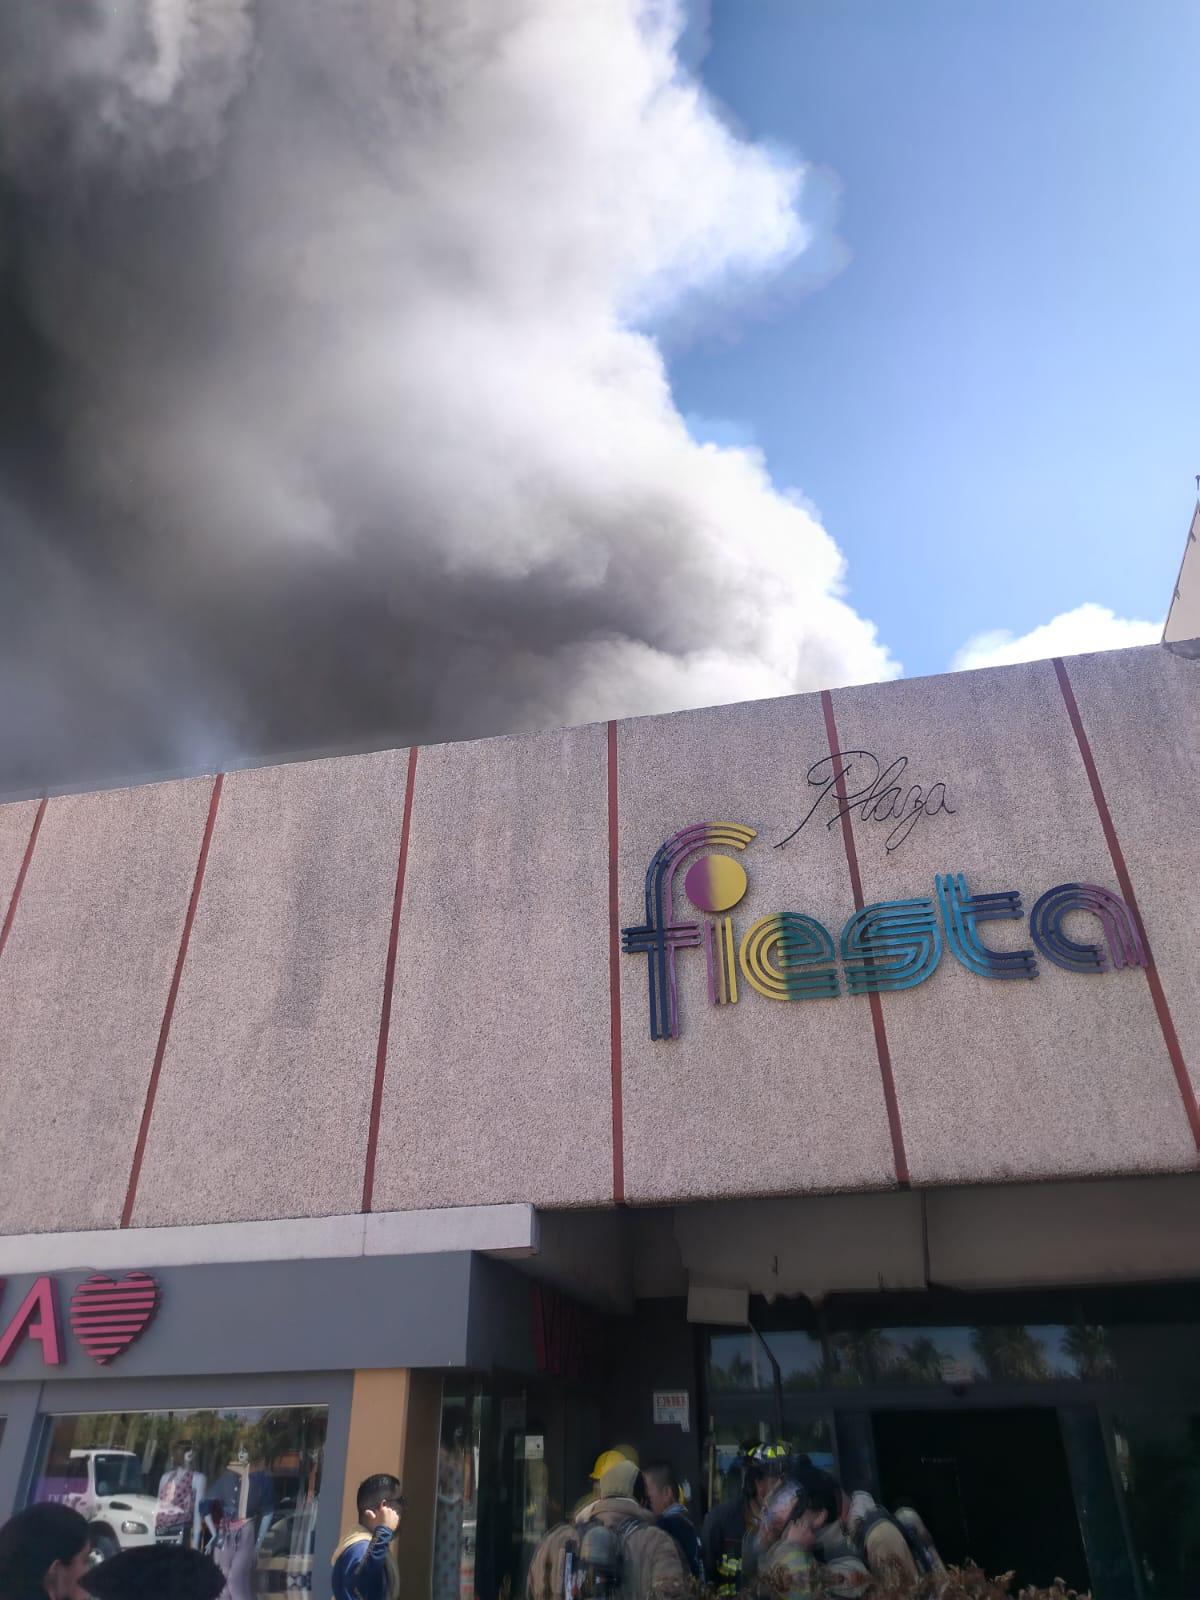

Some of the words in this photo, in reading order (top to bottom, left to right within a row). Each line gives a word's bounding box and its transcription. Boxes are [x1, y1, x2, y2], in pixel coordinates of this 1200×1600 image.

[773, 750, 956, 854] Plaza
[621, 821, 1149, 1041] fiesta
[0, 1275, 65, 1366] A
